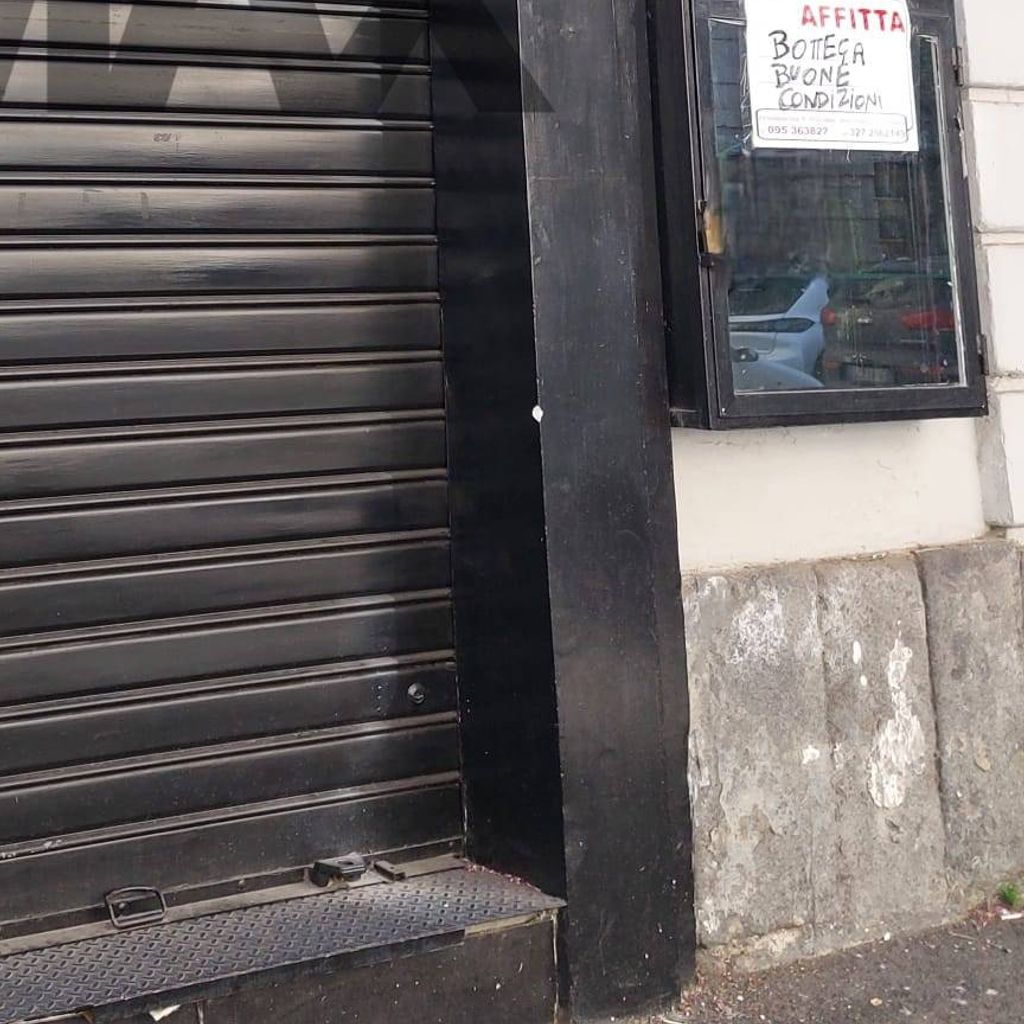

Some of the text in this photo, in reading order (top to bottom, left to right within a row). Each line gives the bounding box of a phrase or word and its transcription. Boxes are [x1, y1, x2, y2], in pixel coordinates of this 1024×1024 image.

[800, 4, 906, 33] AFFITTA
[768, 29, 866, 66] BOTTEGA
[771, 62, 851, 88] BUONE
[778, 87, 883, 112] CONDIZIONI
[767, 125, 788, 135] 095
